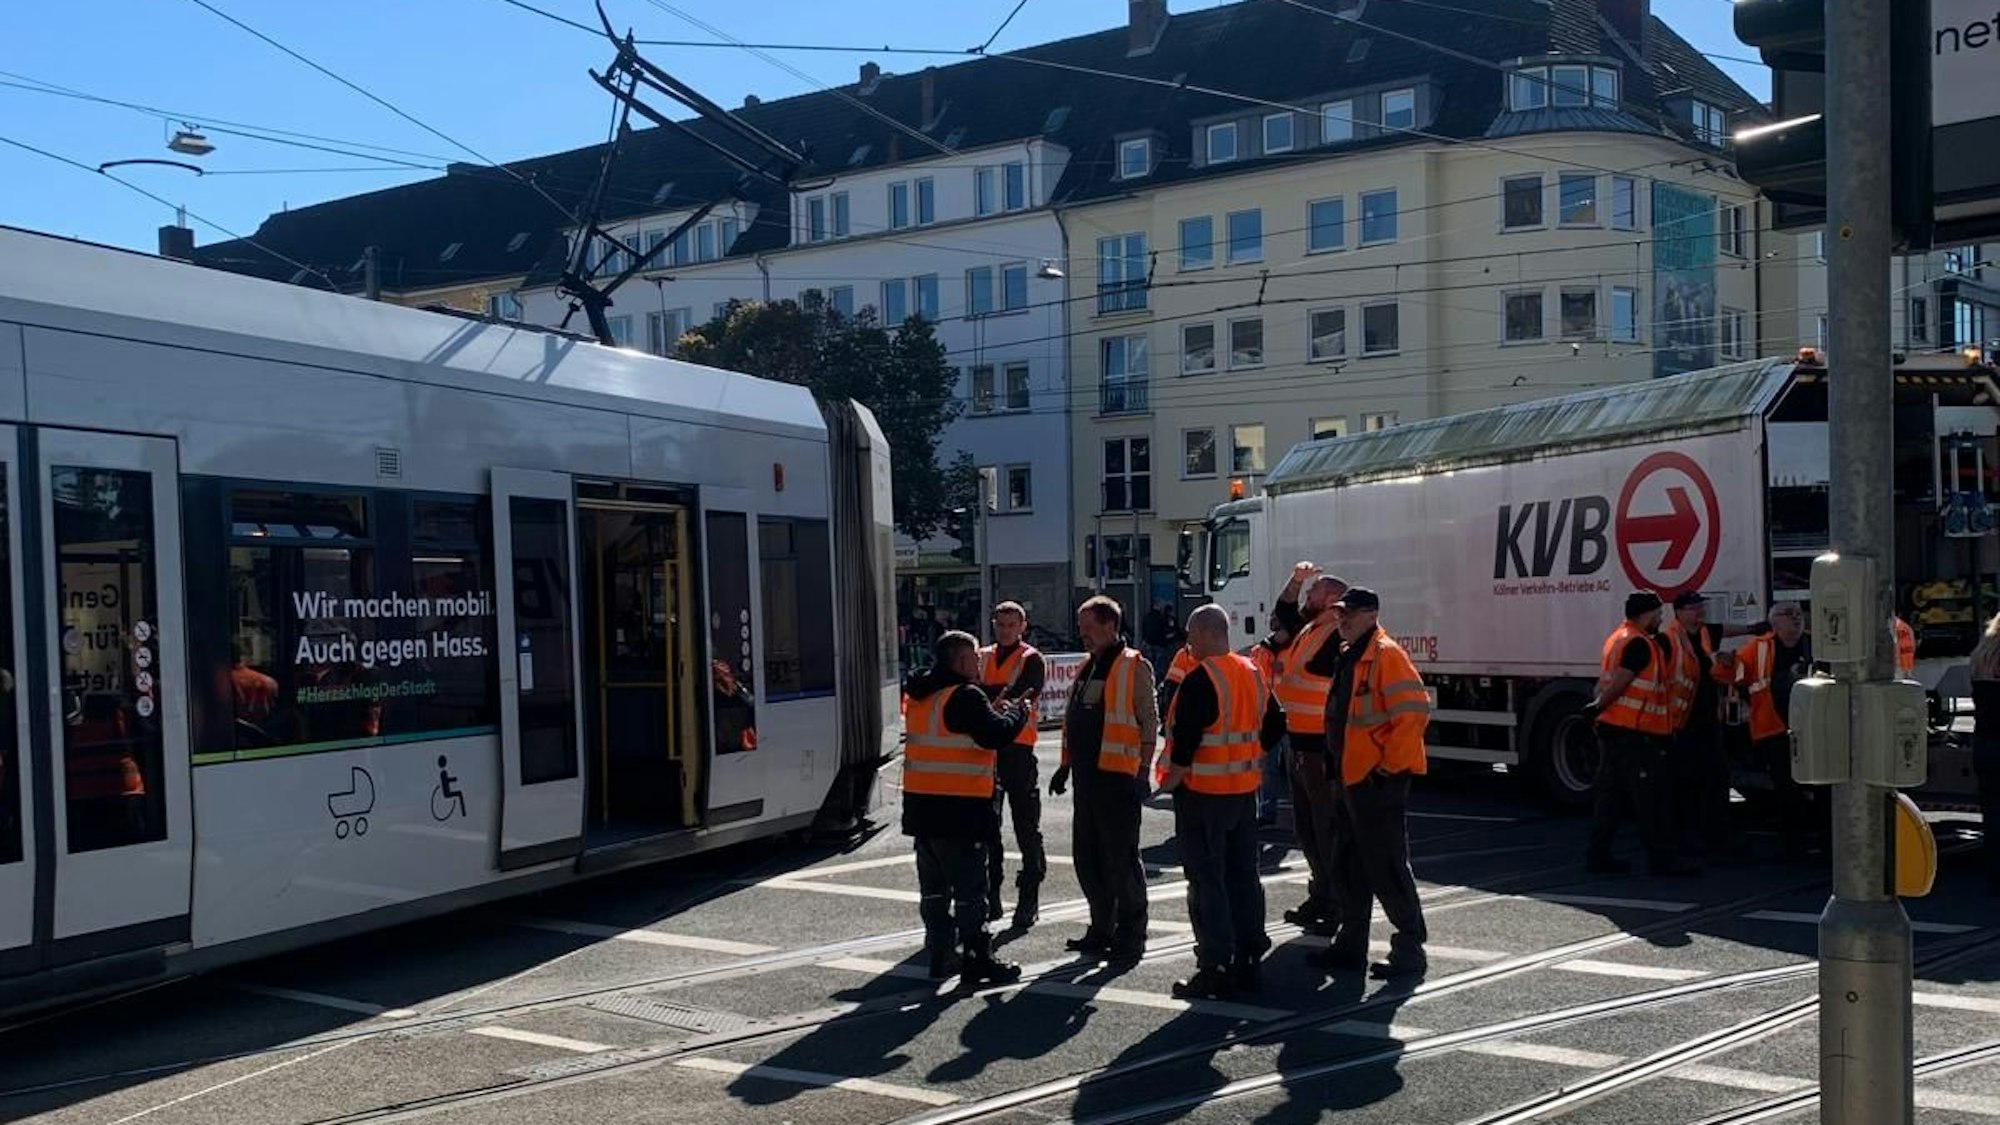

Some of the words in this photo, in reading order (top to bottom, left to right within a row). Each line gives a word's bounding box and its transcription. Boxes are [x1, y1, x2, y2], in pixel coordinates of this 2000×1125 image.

[1493, 495, 1611, 579] KVB
[1493, 583, 1519, 596] Kölner
[1520, 580, 1594, 595] Verkehrs-Betriebe
[1596, 579, 1611, 592] AG
[292, 590, 337, 618] Wir
[344, 590, 429, 617] machen
[435, 589, 494, 616] mobil.
[294, 633, 355, 664] Auch
[361, 637, 427, 669] gegen
[432, 630, 488, 658] Hass.
[297, 679, 436, 704] #HerzschlagDerStadt
